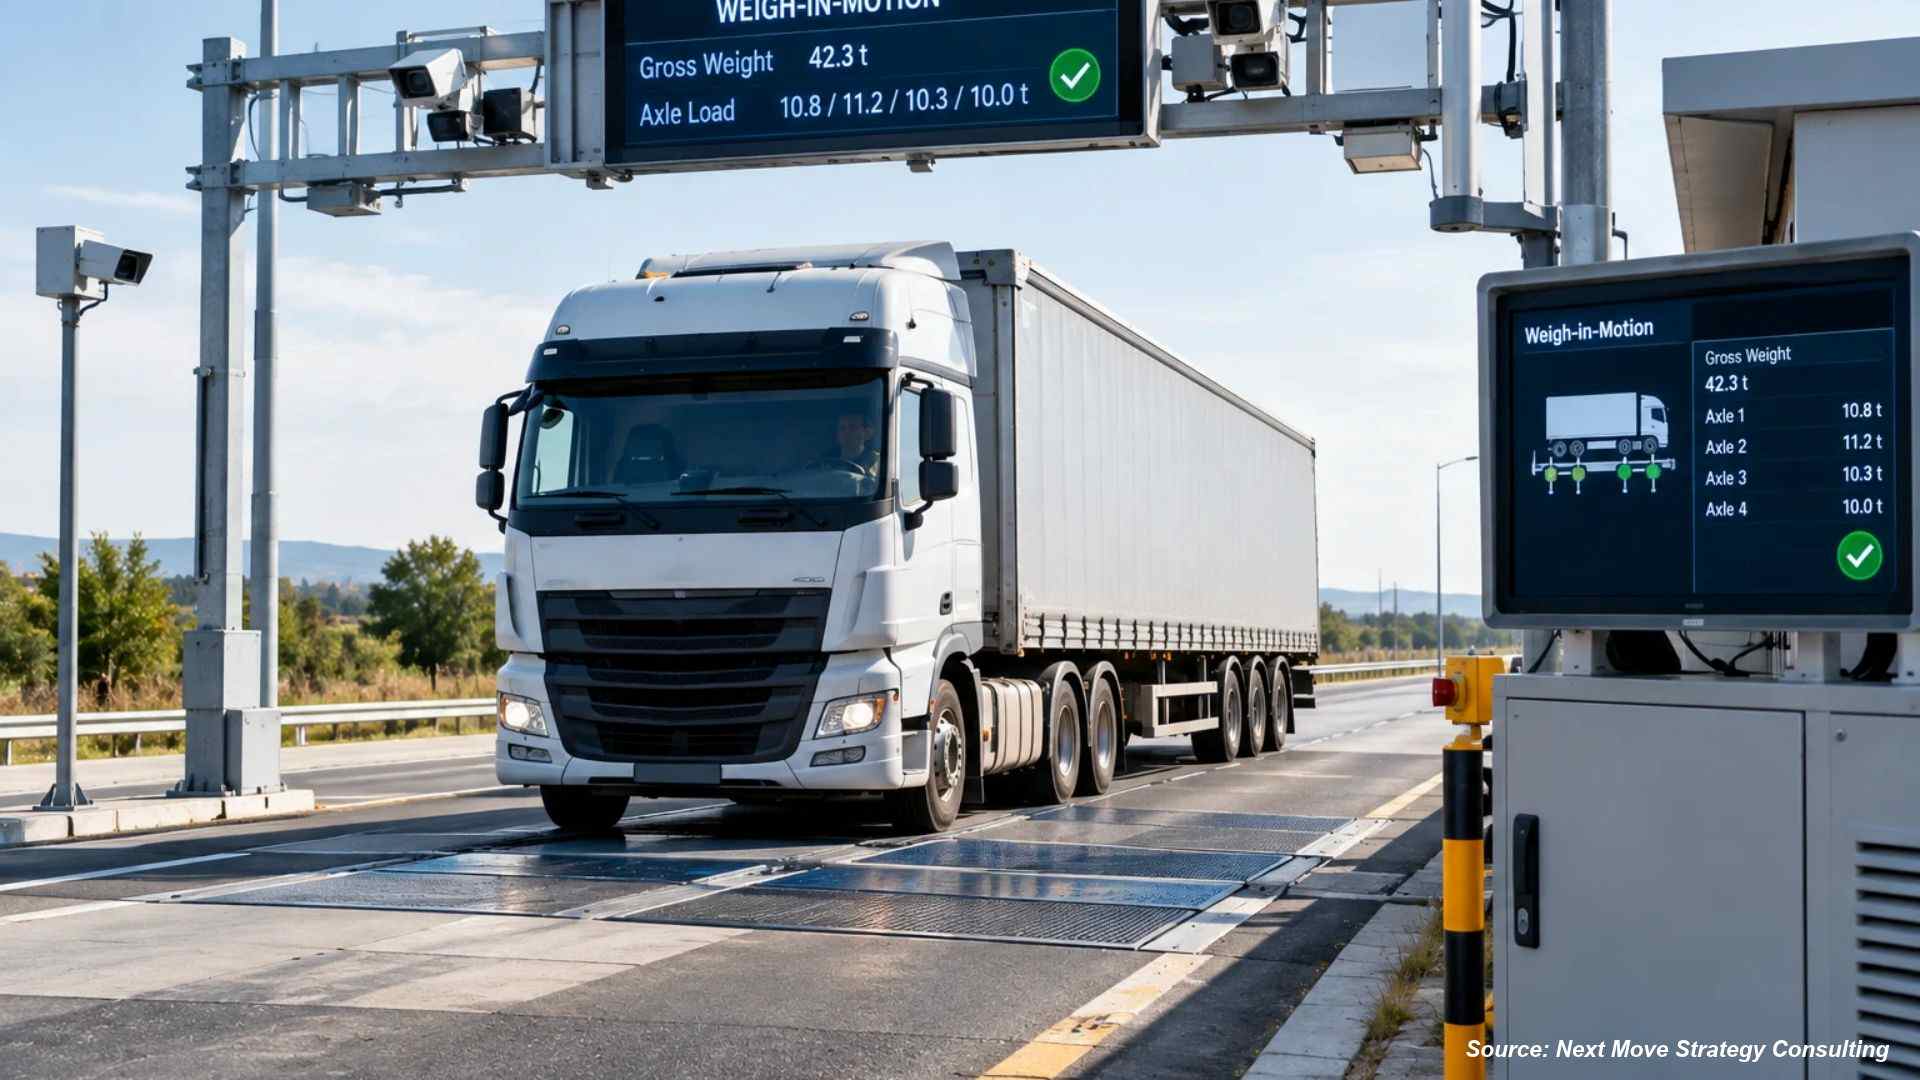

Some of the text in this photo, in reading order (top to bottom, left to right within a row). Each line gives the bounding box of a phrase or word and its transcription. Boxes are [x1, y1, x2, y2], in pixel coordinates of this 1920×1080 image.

[640, 44, 868, 80] Gross Weight 42.3 t
[639, 82, 1029, 127] Axle Load 10.8 / 11.2 / 10.3 / 10.0 t
[1525, 318, 1654, 346] Weigh-in-Motion
[1705, 346, 1792, 366] Gross Weight
[1705, 374, 1749, 393] 42.3 t
[1705, 401, 1883, 425] Axle 1 10.8 t
[1705, 432, 1883, 455] Axle 2 11.2 t
[1705, 465, 1883, 487] Axle 3 10.3 t
[1705, 497, 1883, 517] Axle 4 10.0 t
